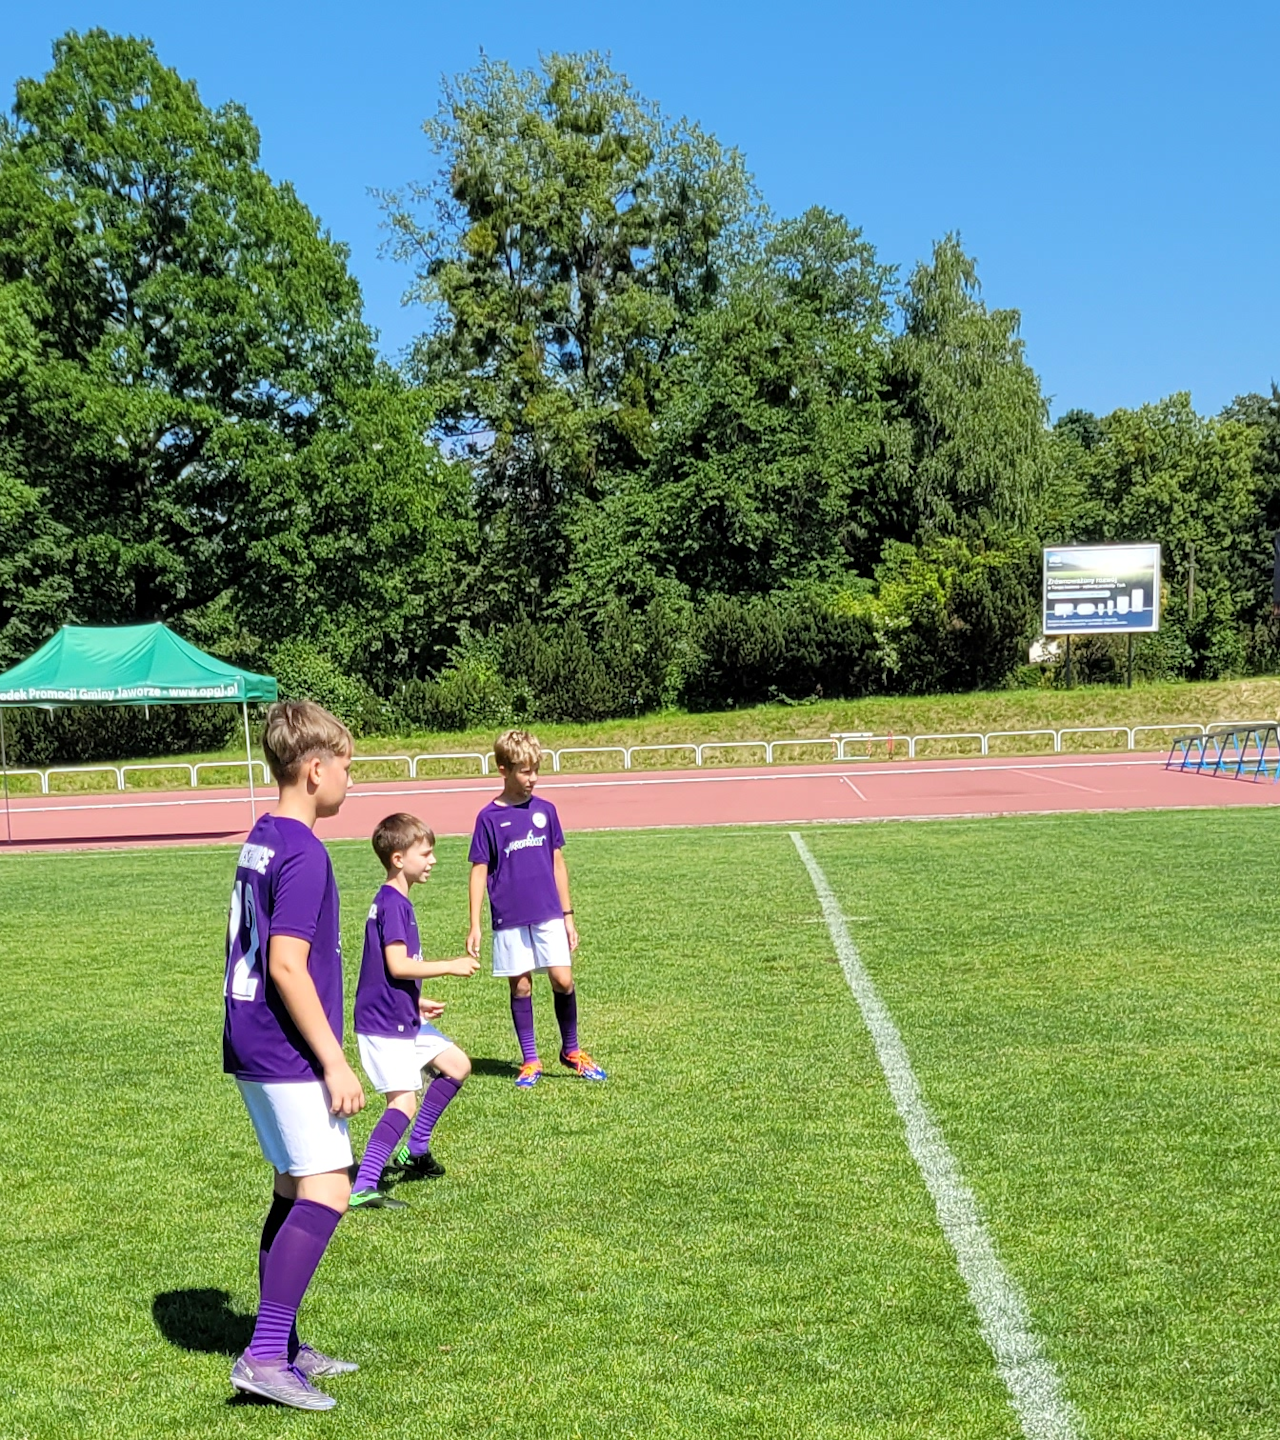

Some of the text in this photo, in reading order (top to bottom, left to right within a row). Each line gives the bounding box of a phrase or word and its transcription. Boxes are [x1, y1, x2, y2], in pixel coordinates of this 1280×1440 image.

[28, 687, 77, 700] Promocji
[79, 688, 115, 701] Gminy
[116, 686, 161, 698] Jaworze
[169, 682, 238, 699] www.opgj.pl
